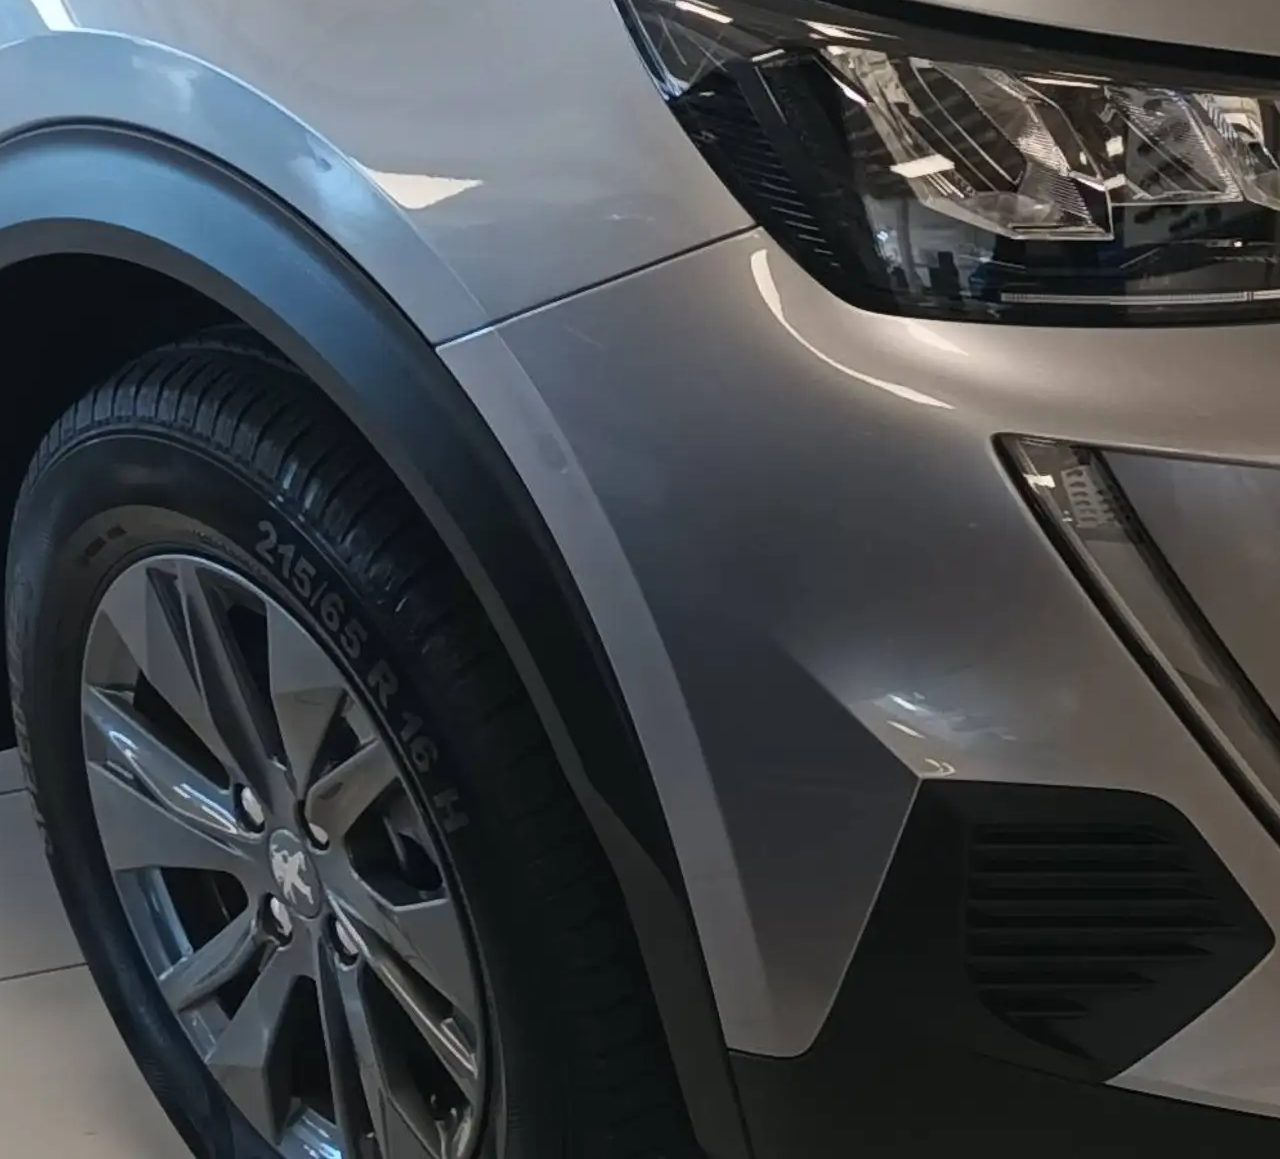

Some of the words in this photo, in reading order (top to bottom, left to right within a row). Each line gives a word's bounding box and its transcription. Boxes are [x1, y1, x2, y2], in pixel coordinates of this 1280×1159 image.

[256, 521, 368, 659] 215/65
[367, 658, 398, 710] R
[399, 711, 439, 772] 16
[433, 788, 470, 833] H
